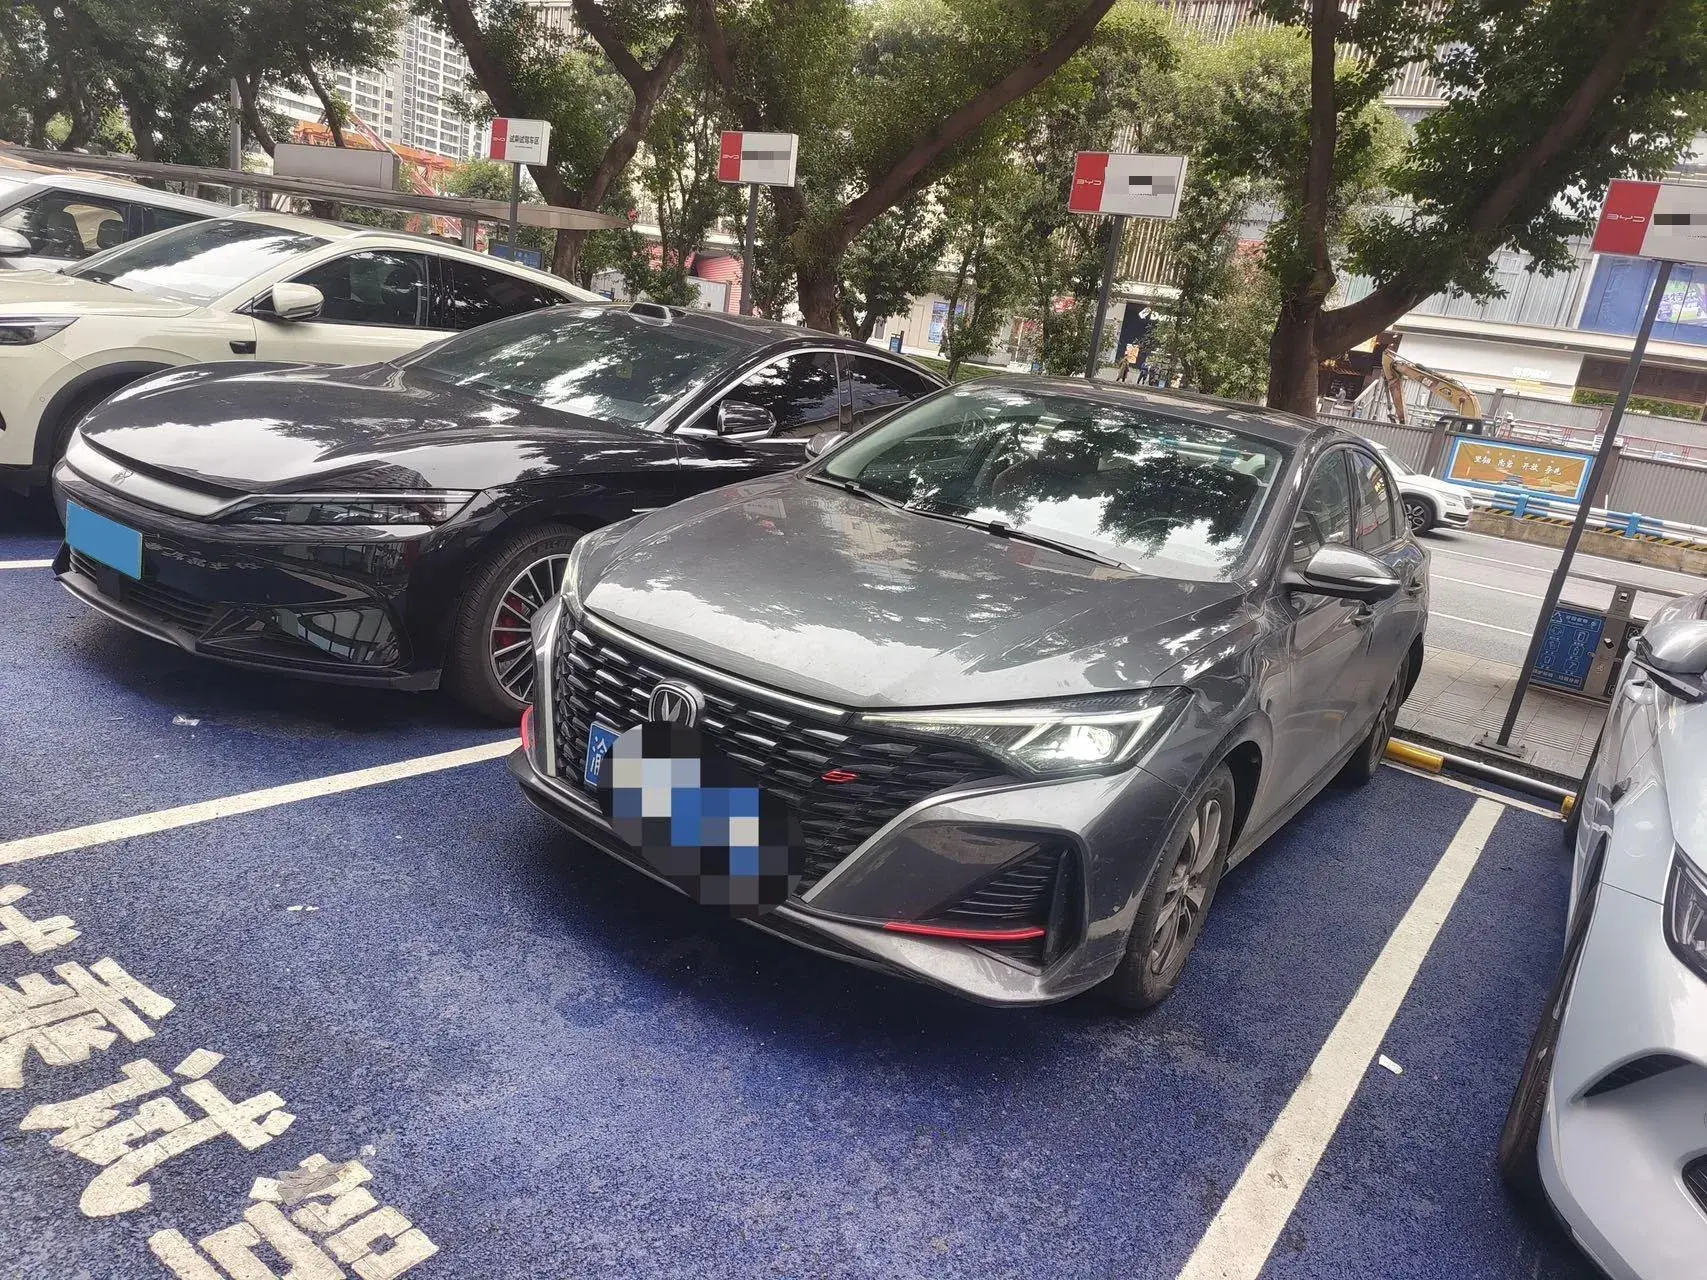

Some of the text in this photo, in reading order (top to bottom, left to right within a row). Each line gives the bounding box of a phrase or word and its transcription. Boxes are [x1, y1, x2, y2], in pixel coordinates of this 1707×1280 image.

[1076, 178, 1102, 186] BYD
[1606, 213, 1646, 223] BYD
[1521, 462, 1539, 472] 开放
